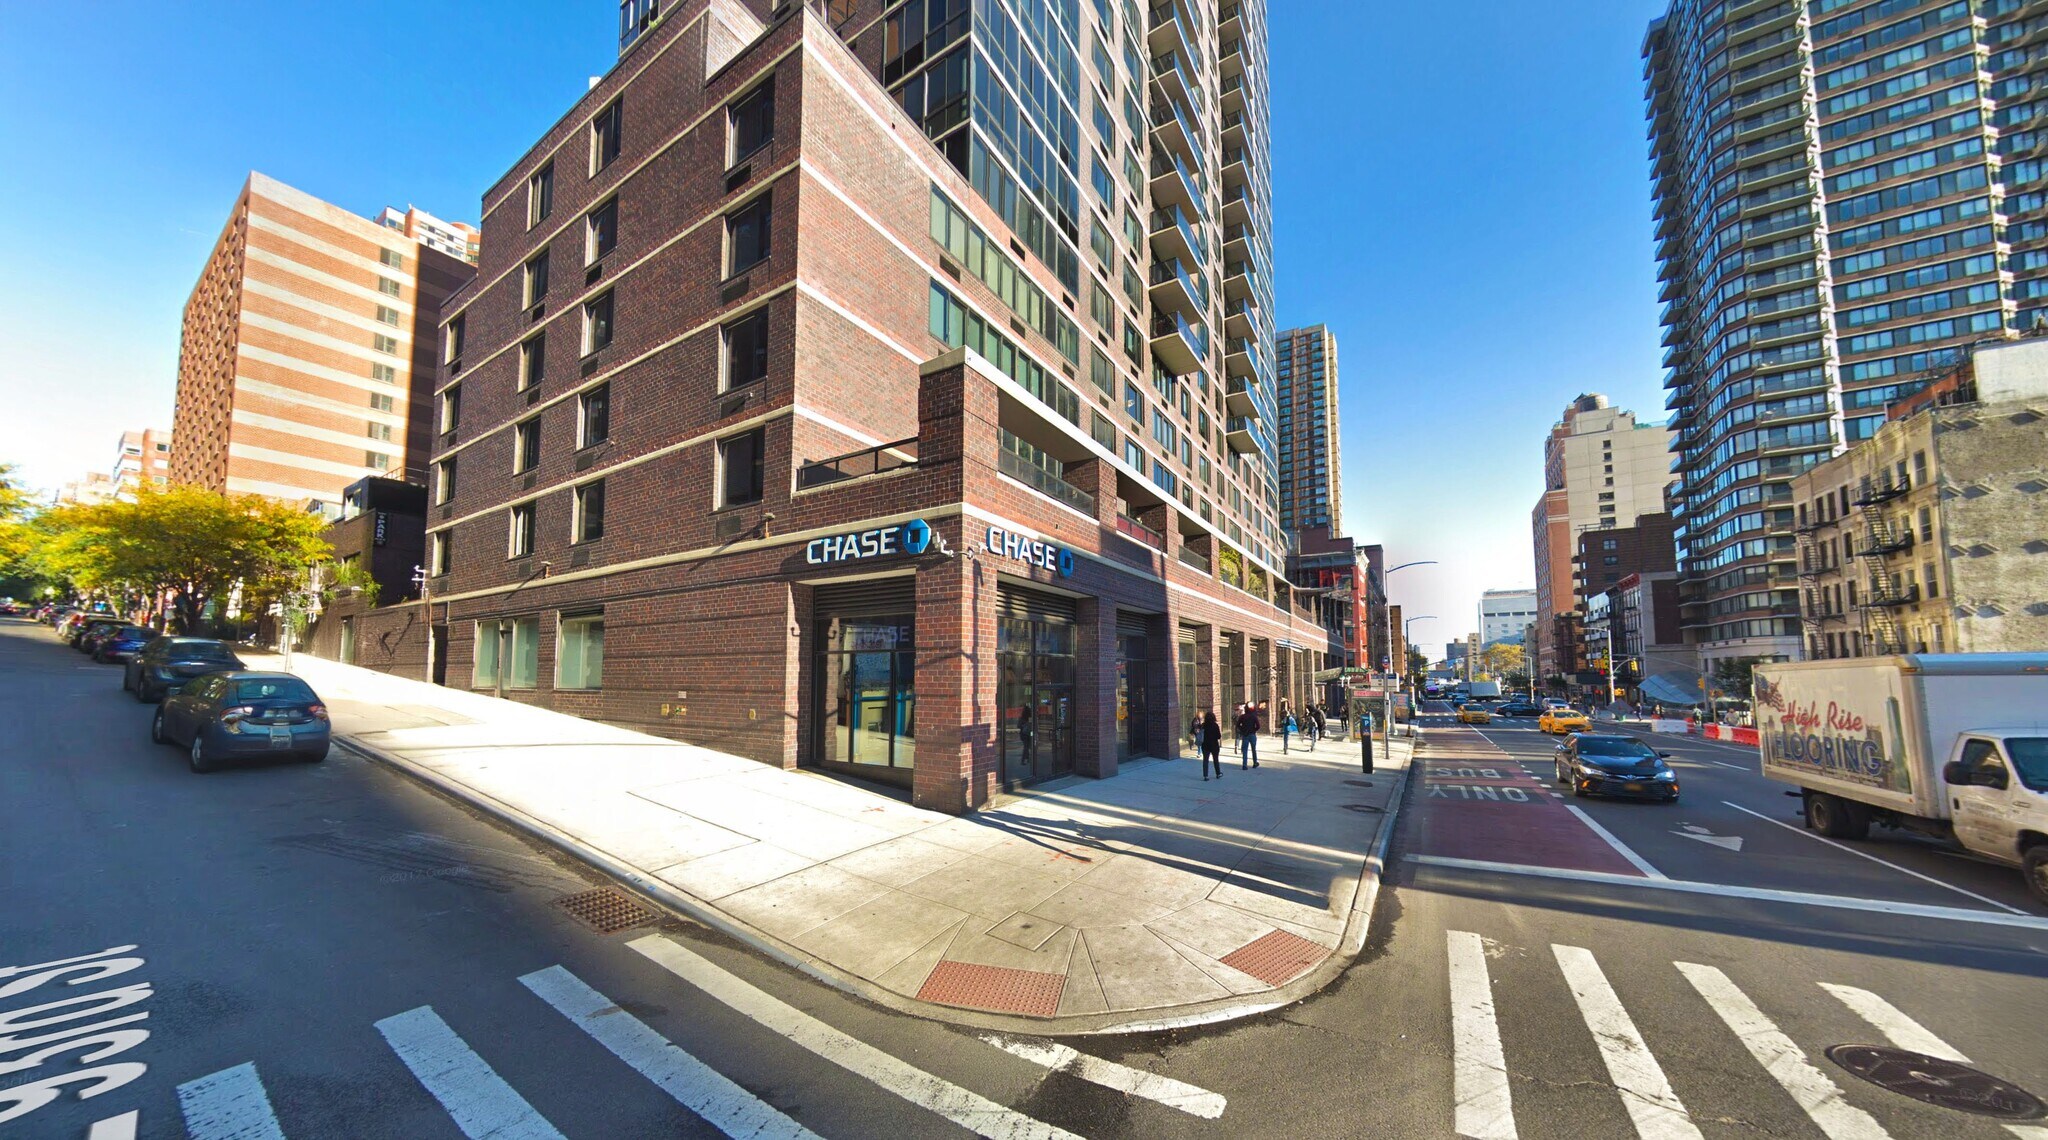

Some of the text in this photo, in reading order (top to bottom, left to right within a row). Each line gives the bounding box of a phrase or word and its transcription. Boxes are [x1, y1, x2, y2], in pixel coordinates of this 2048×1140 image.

[806, 527, 900, 565] CHASE
[986, 525, 1059, 572] CHASE
[1781, 699, 1864, 733] High Rise
[1775, 731, 1883, 776] FLOORING
[1436, 767, 1502, 779] BUS
[1428, 784, 1529, 802] ONLY
